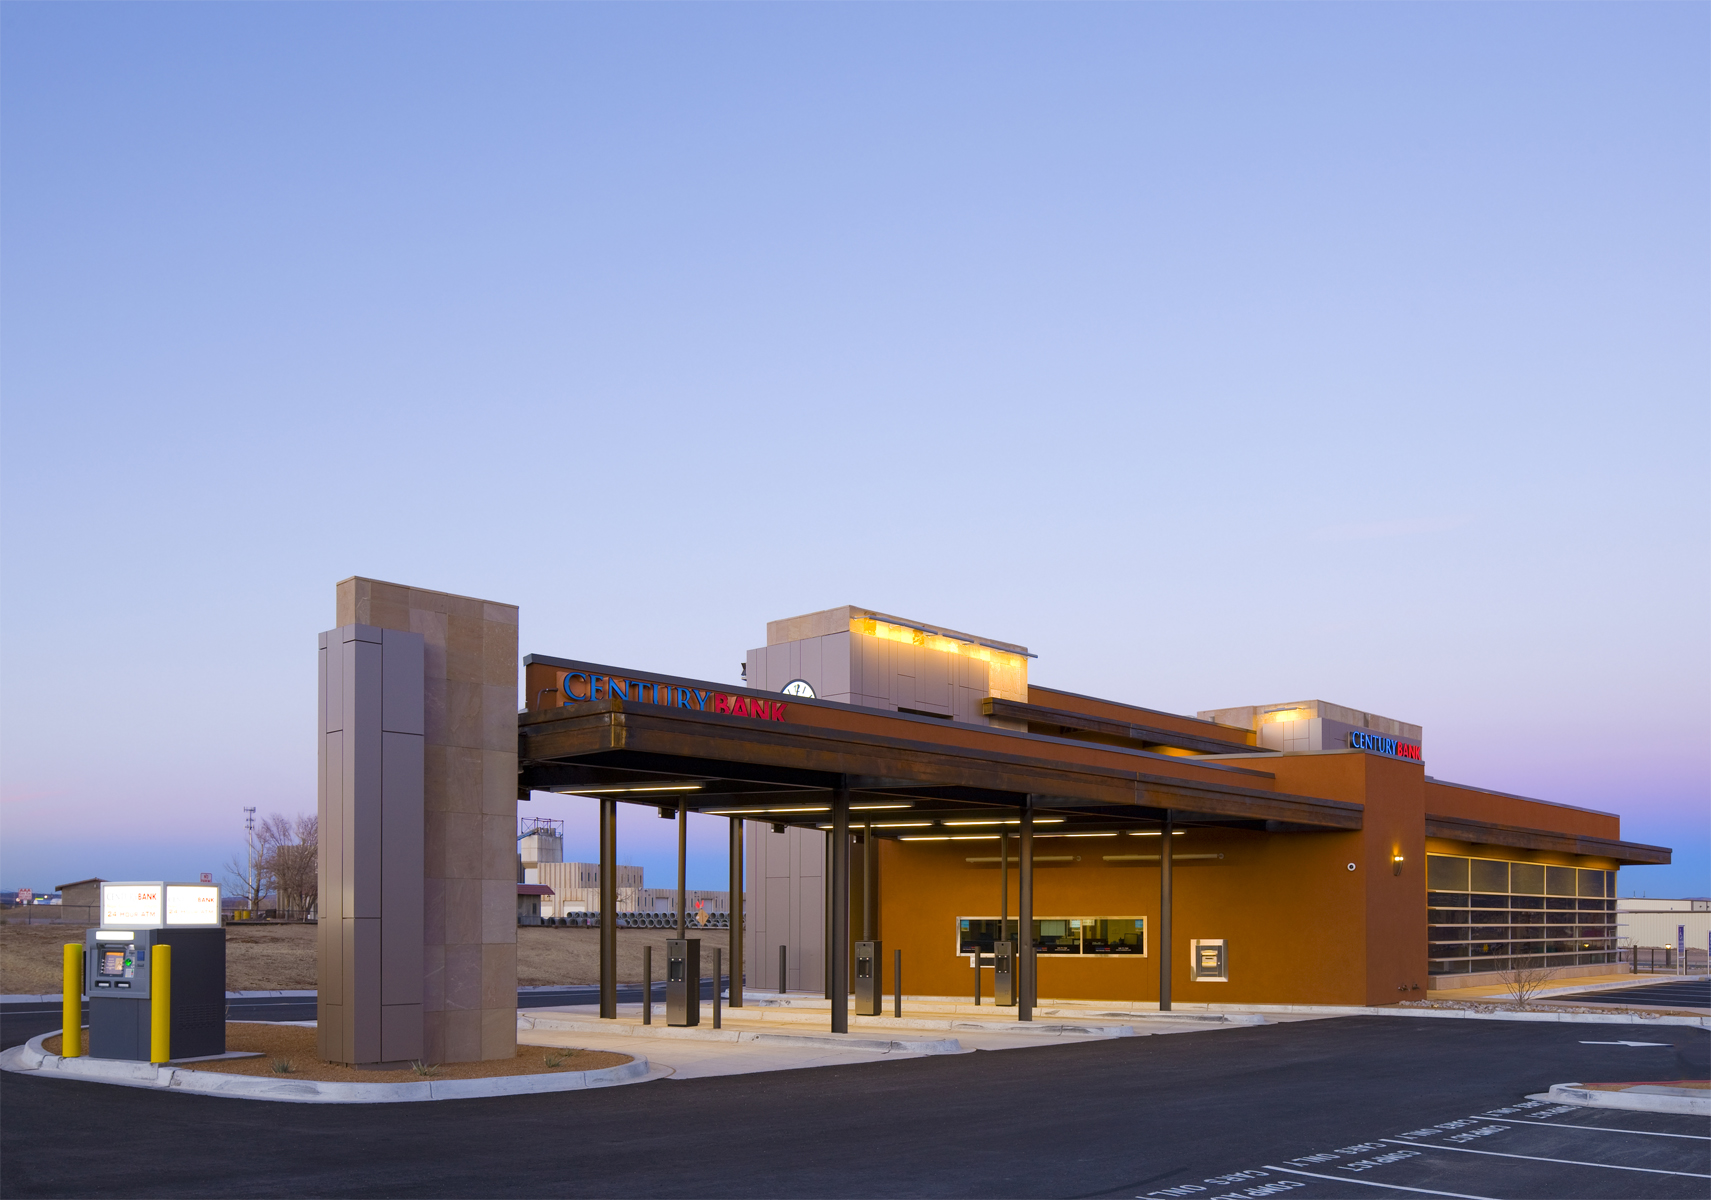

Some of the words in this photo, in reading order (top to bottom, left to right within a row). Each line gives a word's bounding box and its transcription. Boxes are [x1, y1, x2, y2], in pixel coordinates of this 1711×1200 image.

[563, 671, 711, 711] CENTURY
[714, 693, 788, 722] BANK
[1352, 730, 1397, 756] CENTURY
[1397, 741, 1421, 760] BANK
[137, 892, 157, 901] BANK
[1203, 1169, 1270, 1185] CARS
